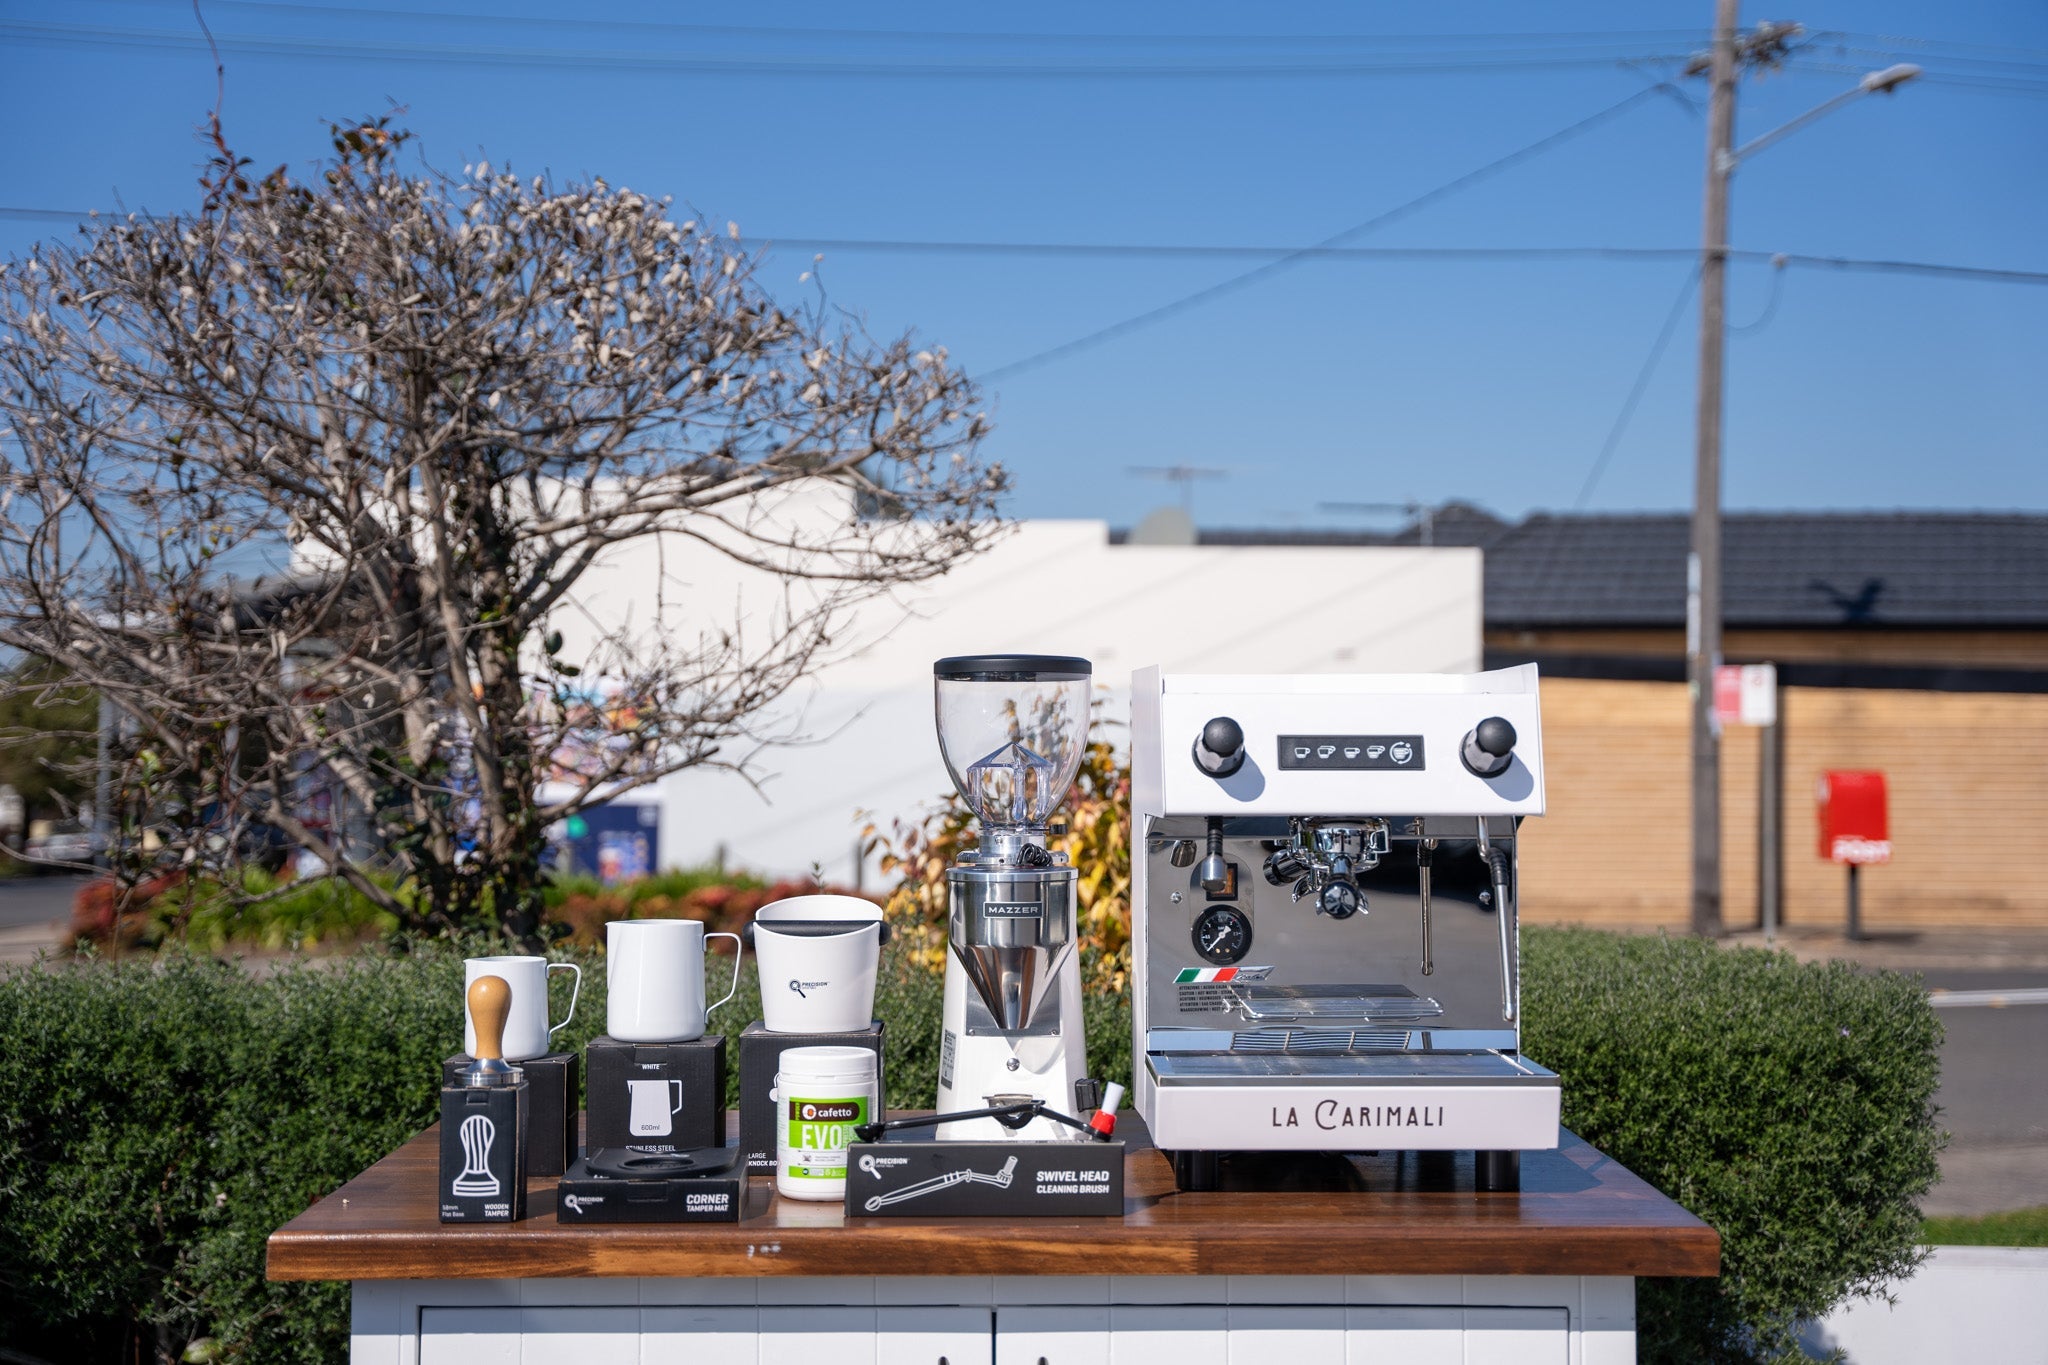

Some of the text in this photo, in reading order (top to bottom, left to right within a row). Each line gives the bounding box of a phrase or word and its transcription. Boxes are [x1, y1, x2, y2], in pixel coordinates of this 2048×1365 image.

[988, 906, 1038, 914] MAZZER
[818, 1107, 852, 1118] cafetto
[1272, 1099, 1443, 1130] LA CARIMALI
[802, 1124, 842, 1149] EVO
[658, 1144, 676, 1152] STEEL
[876, 1157, 908, 1165] PRECISION
[1036, 1170, 1110, 1182] SWIVEL HEAD
[1036, 1184, 1110, 1194] CLEANING BRUSH
[686, 1193, 729, 1205] CORNER
[686, 1204, 729, 1212] TAMPER MAT
